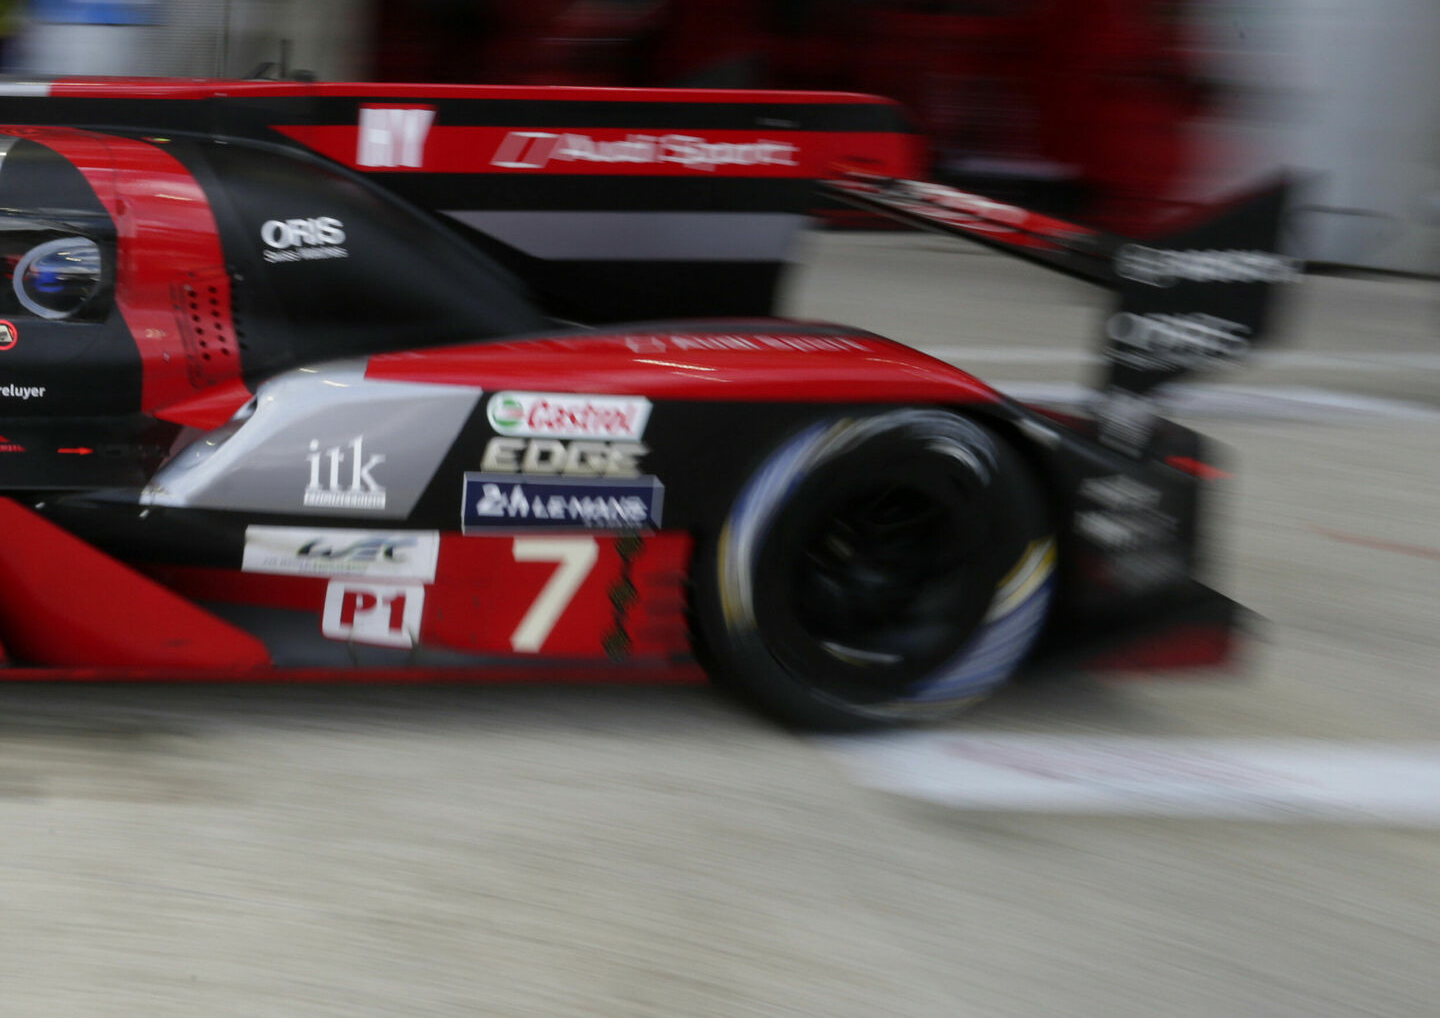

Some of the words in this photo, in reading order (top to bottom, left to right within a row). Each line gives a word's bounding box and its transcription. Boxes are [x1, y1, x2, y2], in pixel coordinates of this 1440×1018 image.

[549, 133, 659, 163] Audi
[659, 134, 800, 172] Sport
[261, 216, 346, 249] ORIS
[528, 399, 637, 431] Castrol
[305, 435, 386, 492] itk
[480, 437, 650, 477] EDGE
[340, 590, 407, 635] P1
[511, 536, 599, 653] 7
